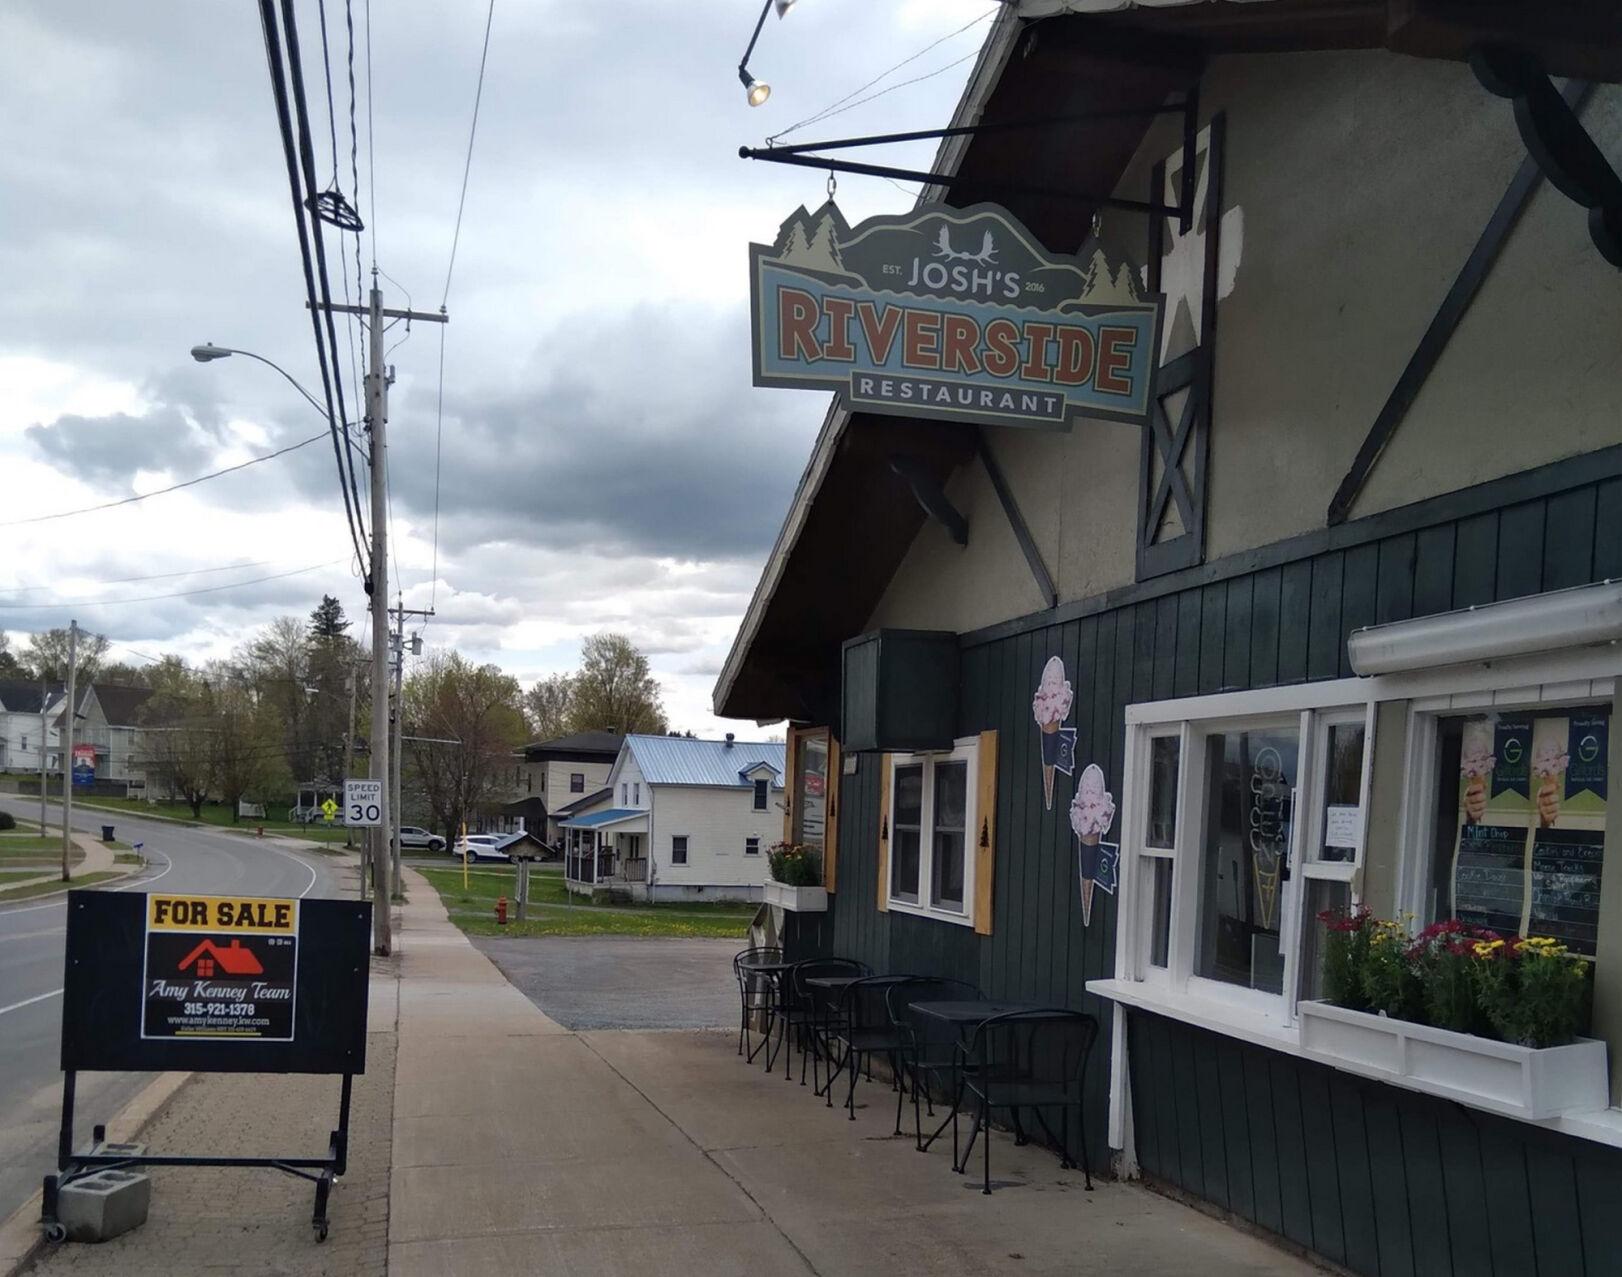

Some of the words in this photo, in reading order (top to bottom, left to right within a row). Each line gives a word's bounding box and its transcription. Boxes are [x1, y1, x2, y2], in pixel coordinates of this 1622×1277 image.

[882, 263, 902, 276] EST.
[907, 257, 1021, 299] JOSH'S
[776, 285, 1139, 397] RIVERSIDE
[859, 378, 1057, 414] RESTAURANT
[347, 783, 380, 792] SPEED
[350, 793, 376, 801] LIMIT
[350, 804, 380, 821] 30
[154, 900, 208, 926] FOR
[216, 902, 291, 928] SALE
[149, 979, 189, 1001] Amy
[192, 981, 247, 1002] Kenney
[251, 982, 291, 999] Team
[184, 1002, 255, 1016] 315-921-1378
